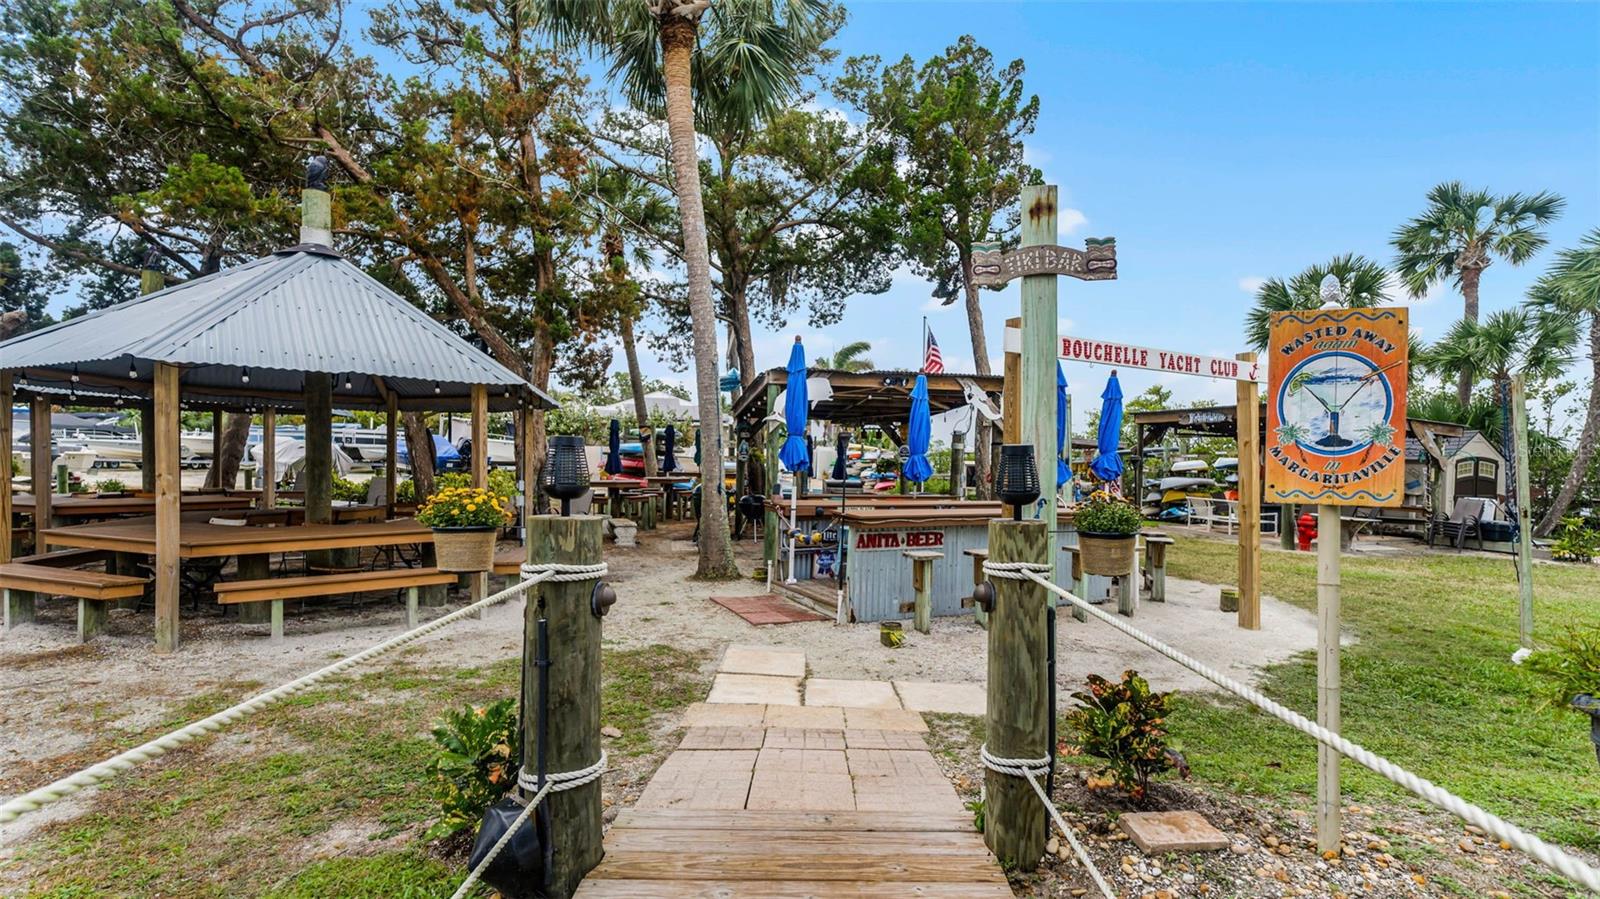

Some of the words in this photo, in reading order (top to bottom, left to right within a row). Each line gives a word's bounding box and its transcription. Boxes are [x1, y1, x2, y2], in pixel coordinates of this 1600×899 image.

[1045, 250, 1082, 271] BAR
[1281, 326, 1347, 355] WASTED
[1352, 328, 1396, 354] AWAY
[1313, 340, 1358, 351] again
[1062, 338, 1148, 367] BOUCHELLE
[1159, 352, 1201, 373] YACHT
[1210, 359, 1238, 377] CLUB
[1269, 446, 1401, 484] MARGARITAVILLE
[856, 533, 900, 548] ANITA
[906, 531, 944, 546] BEER
